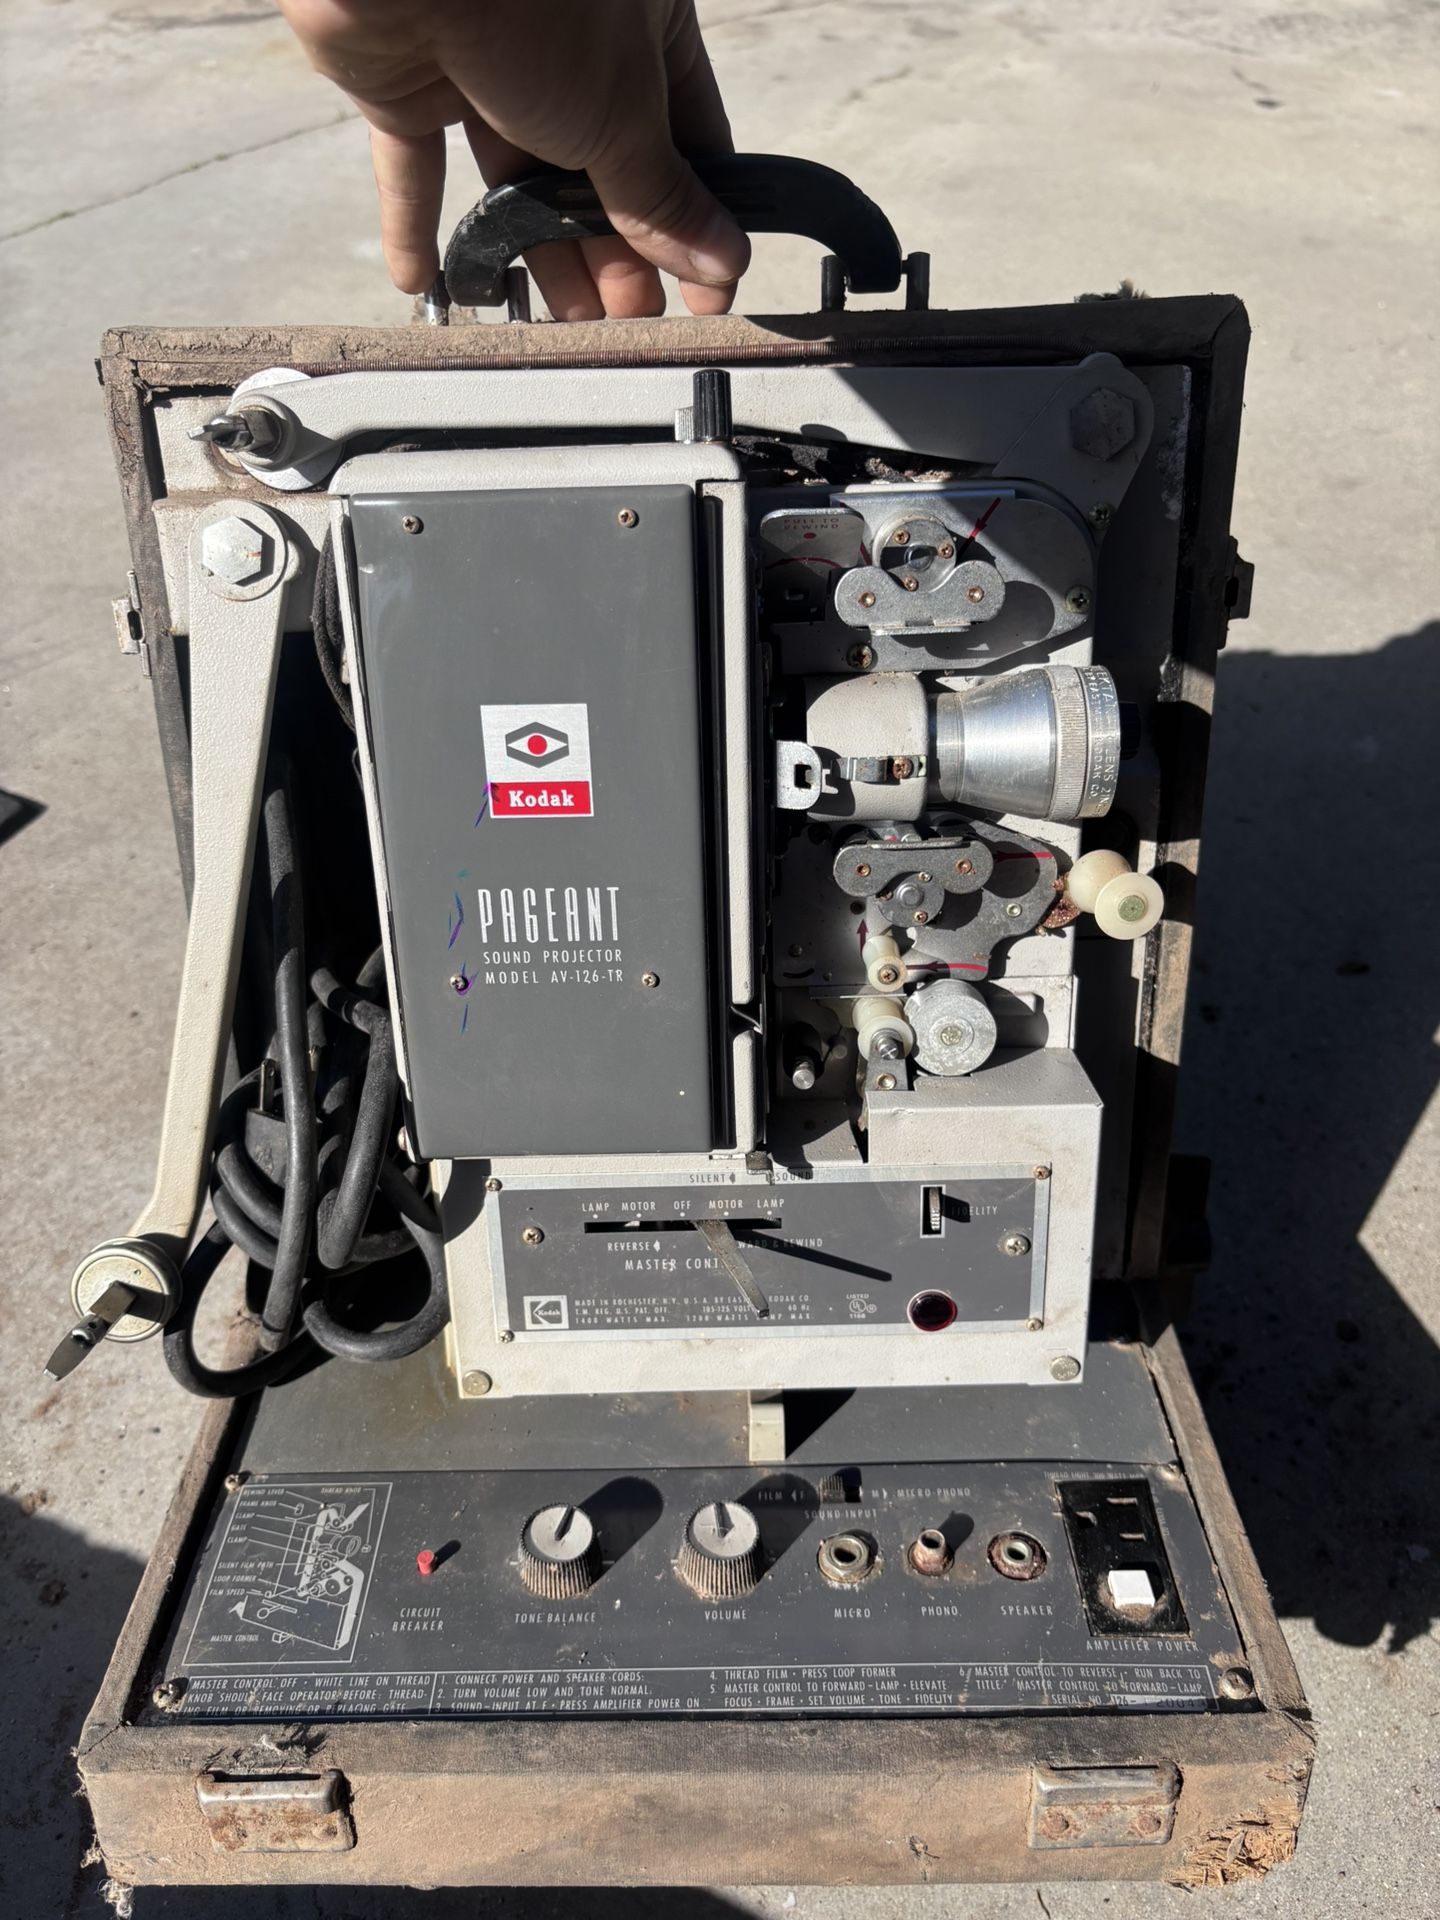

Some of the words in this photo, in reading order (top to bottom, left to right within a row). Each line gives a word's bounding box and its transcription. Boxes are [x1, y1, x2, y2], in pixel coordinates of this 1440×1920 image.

[508, 790, 575, 807] Kodak
[478, 887, 619, 943] PAGEANT
[484, 951, 531, 964] SOUND
[543, 949, 622, 963] PROJECTOR
[485, 971, 540, 984] MODEL
[551, 969, 624, 984] AV-126-TR
[689, 1173, 726, 1184] SILENT
[774, 1172, 812, 1182] SOUND
[582, 1202, 610, 1212] LAMP
[621, 1201, 656, 1212] MOTOR
[674, 1200, 691, 1210] OFF
[708, 1199, 743, 1209] MOTOR
[757, 1198, 785, 1208] LAMP
[607, 1241, 650, 1252] REVERSE
[737, 1239, 767, 1250] WARD
[783, 1238, 823, 1248] REWIND
[625, 1258, 677, 1271] MASTER
[686, 1257, 720, 1270] CONT
[538, 1309, 562, 1317] Kodak
[758, 1490, 783, 1500] FILM
[872, 1489, 880, 1498] M
[897, 1487, 970, 1498] MICRO-PHONO
[400, 1607, 441, 1618] CIRCUIT
[704, 1609, 747, 1621] VOLUME
[834, 1607, 871, 1618] MICRO
[921, 1605, 958, 1617] PHONO
[1001, 1604, 1053, 1616] SPEAKER
[514, 1612, 543, 1624] TONE
[547, 1612, 596, 1624] BALANCE
[392, 1620, 444, 1632] BREAKER
[1086, 1639, 1150, 1651] AMPLIFIER
[1158, 1640, 1199, 1652] POWER
[441, 1675, 448, 1685] 1.
[455, 1673, 497, 1685] CONNECT
[502, 1673, 534, 1684] POWER
[540, 1673, 560, 1683] AND
[566, 1672, 606, 1683] SPEAKER
[709, 1670, 718, 1680] 4.
[724, 1669, 760, 1680] THREAD
[766, 1669, 788, 1680] FILM
[802, 1668, 828, 1678] PRESS
[833, 1667, 855, 1678] LOOP
[861, 1666, 896, 1677] FORMER
[975, 1666, 1010, 1677] MASTER
[1015, 1666, 1055, 1677] CONTROL
[1062, 1666, 1074, 1676] TO
[1080, 1667, 1117, 1678] REVERSE
[1134, 1667, 1153, 1679] RUN
[1159, 1668, 1183, 1679] BACK
[1187, 1668, 1201, 1680] TO
[191, 1679, 229, 1690] MASTER
[280, 1677, 298, 1688] OFF
[315, 1676, 344, 1687] WHITE
[349, 1676, 370, 1687] LINE
[376, 1676, 390, 1686] ON
[396, 1675, 431, 1686] THREAD
[710, 1683, 718, 1694] 5.
[724, 1683, 759, 1694] MASTER
[763, 1682, 802, 1693] CONTROL
[806, 1681, 818, 1692] TO
[1059, 1680, 1101, 1691] CONTROL
[187, 1692, 213, 1703] KNOB
[219, 1692, 251, 1703] SHOUL
[261, 1691, 283, 1702] FACE
[290, 1690, 336, 1701] OPERATOR
[343, 1689, 377, 1700] BEFORE
[389, 1689, 427, 1700] THREAD-
[437, 1688, 446, 1699] 2.
[453, 1688, 477, 1698] TURN
[484, 1687, 521, 1698] VOLUME
[527, 1687, 548, 1697] LOW
[554, 1686, 574, 1697] AND
[580, 1686, 605, 1696] TONE
[1051, 1693, 1082, 1705] SERIAL
[525, 1701, 537, 1711] AT
[542, 1701, 547, 1711] F
[560, 1700, 588, 1711] PRESS
[593, 1698, 642, 1710] AMPLIFIER
[648, 1698, 681, 1709] POWER
[686, 1697, 700, 1708] ON
[724, 1696, 752, 1707] FOCUS
[766, 1695, 795, 1706] FRAME
[808, 1695, 823, 1706] SET
[829, 1694, 866, 1705] VOLUME
[879, 1693, 902, 1704] TONE
[915, 1693, 953, 1704] FIDELITY
